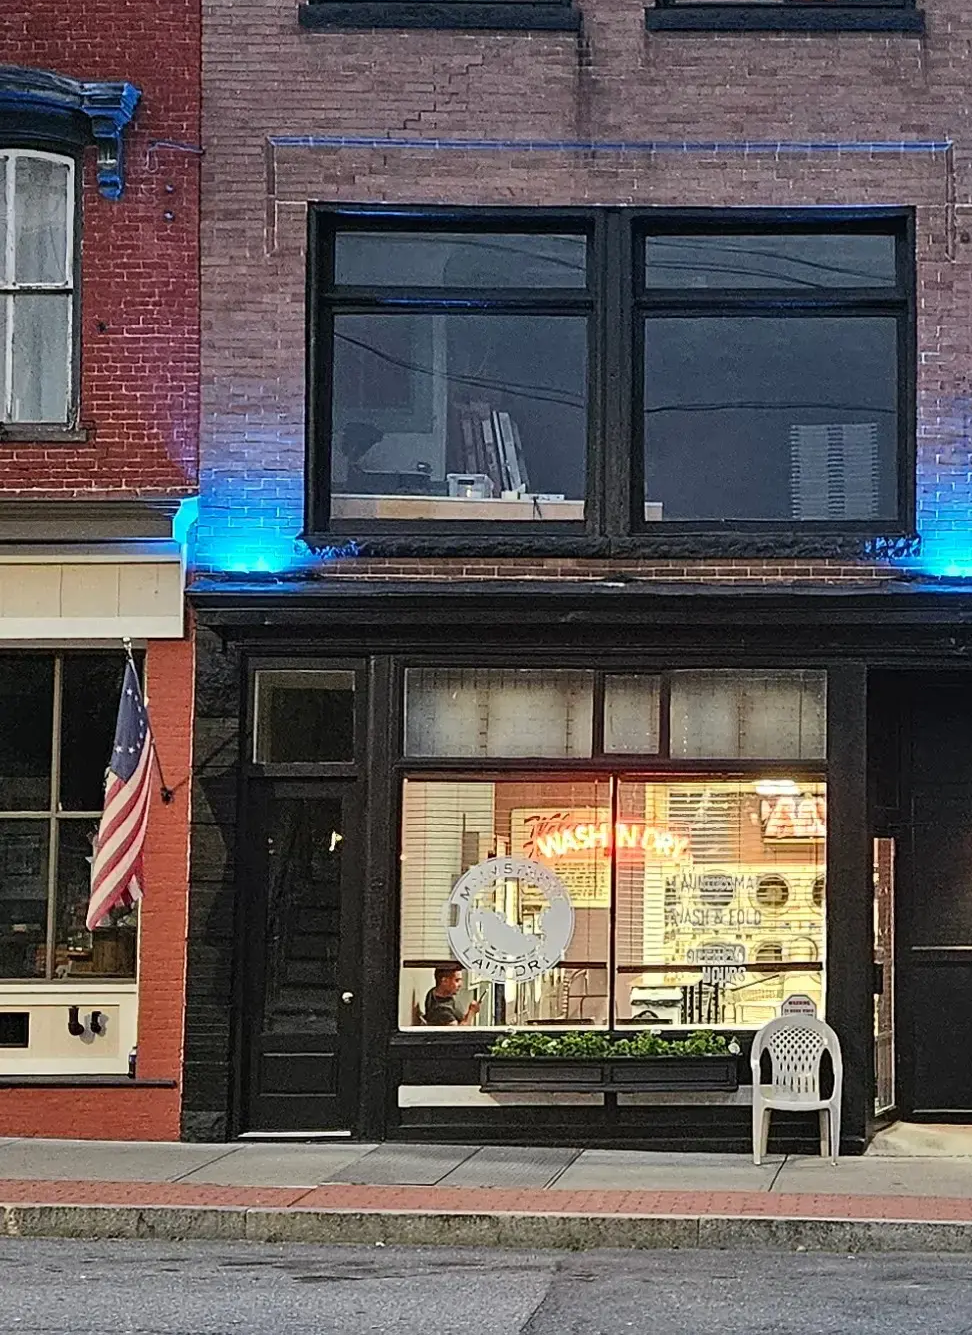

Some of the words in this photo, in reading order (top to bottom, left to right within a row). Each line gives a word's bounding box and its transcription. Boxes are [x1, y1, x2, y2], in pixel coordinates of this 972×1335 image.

[536, 822, 607, 858] WASH
[641, 826, 689, 858] DRY
[729, 908, 762, 926] FOLD
[702, 966, 747, 984] HOURS
